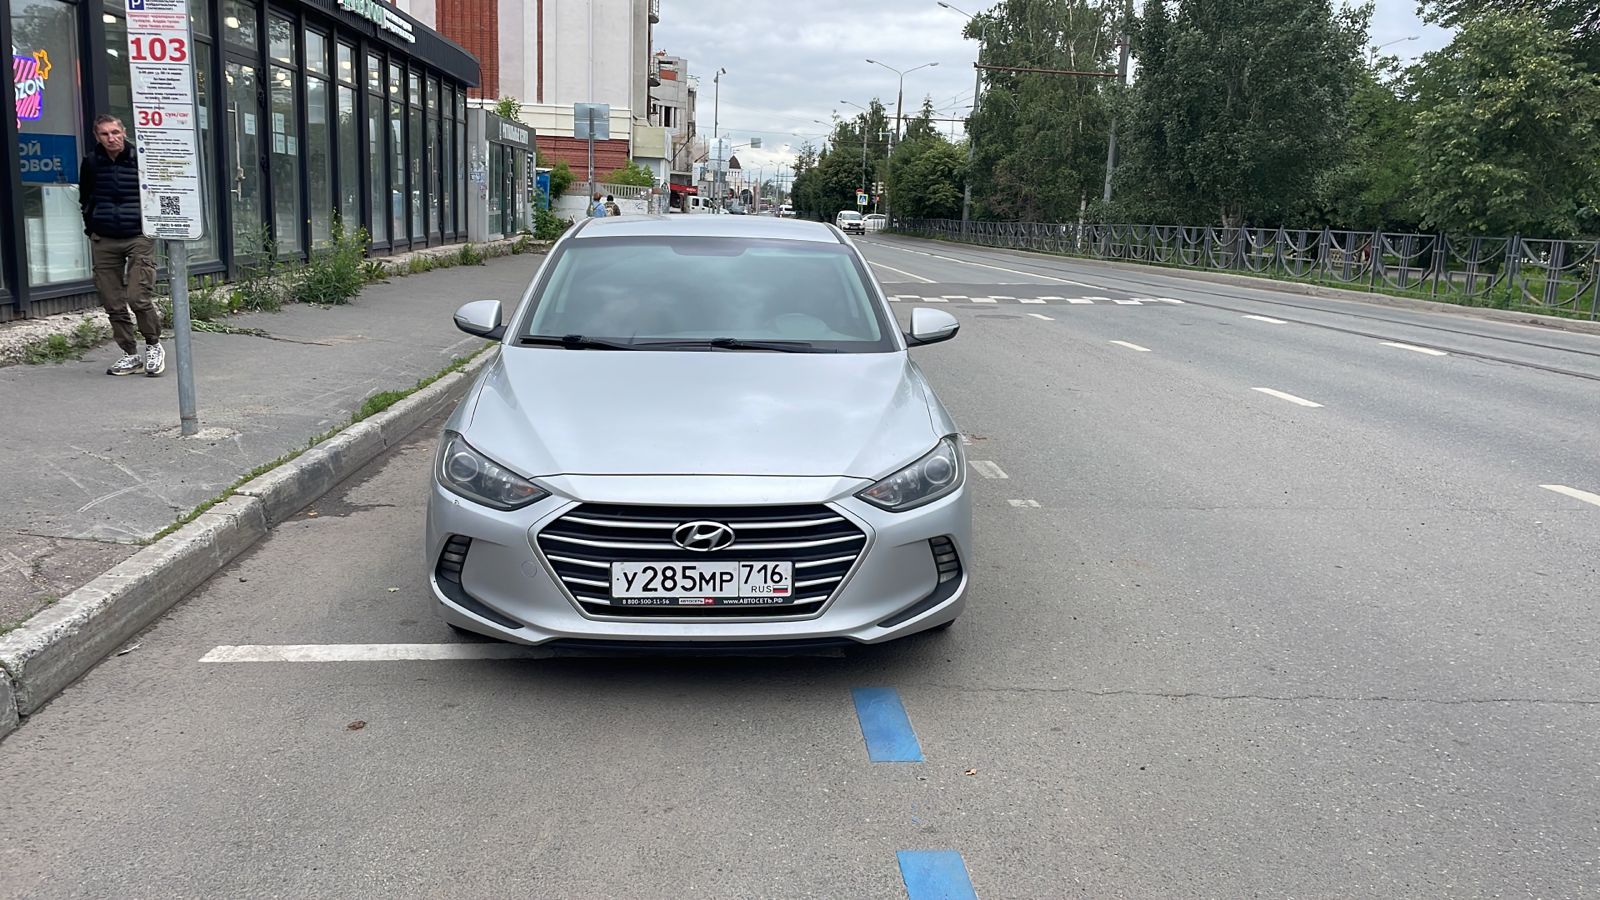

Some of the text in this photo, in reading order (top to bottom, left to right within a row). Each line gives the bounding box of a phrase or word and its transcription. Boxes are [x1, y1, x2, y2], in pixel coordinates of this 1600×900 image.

[131, 37, 187, 62] 103
[138, 110, 163, 126] 30
[741, 564, 784, 585] 716
[751, 585, 772, 593] RUS
